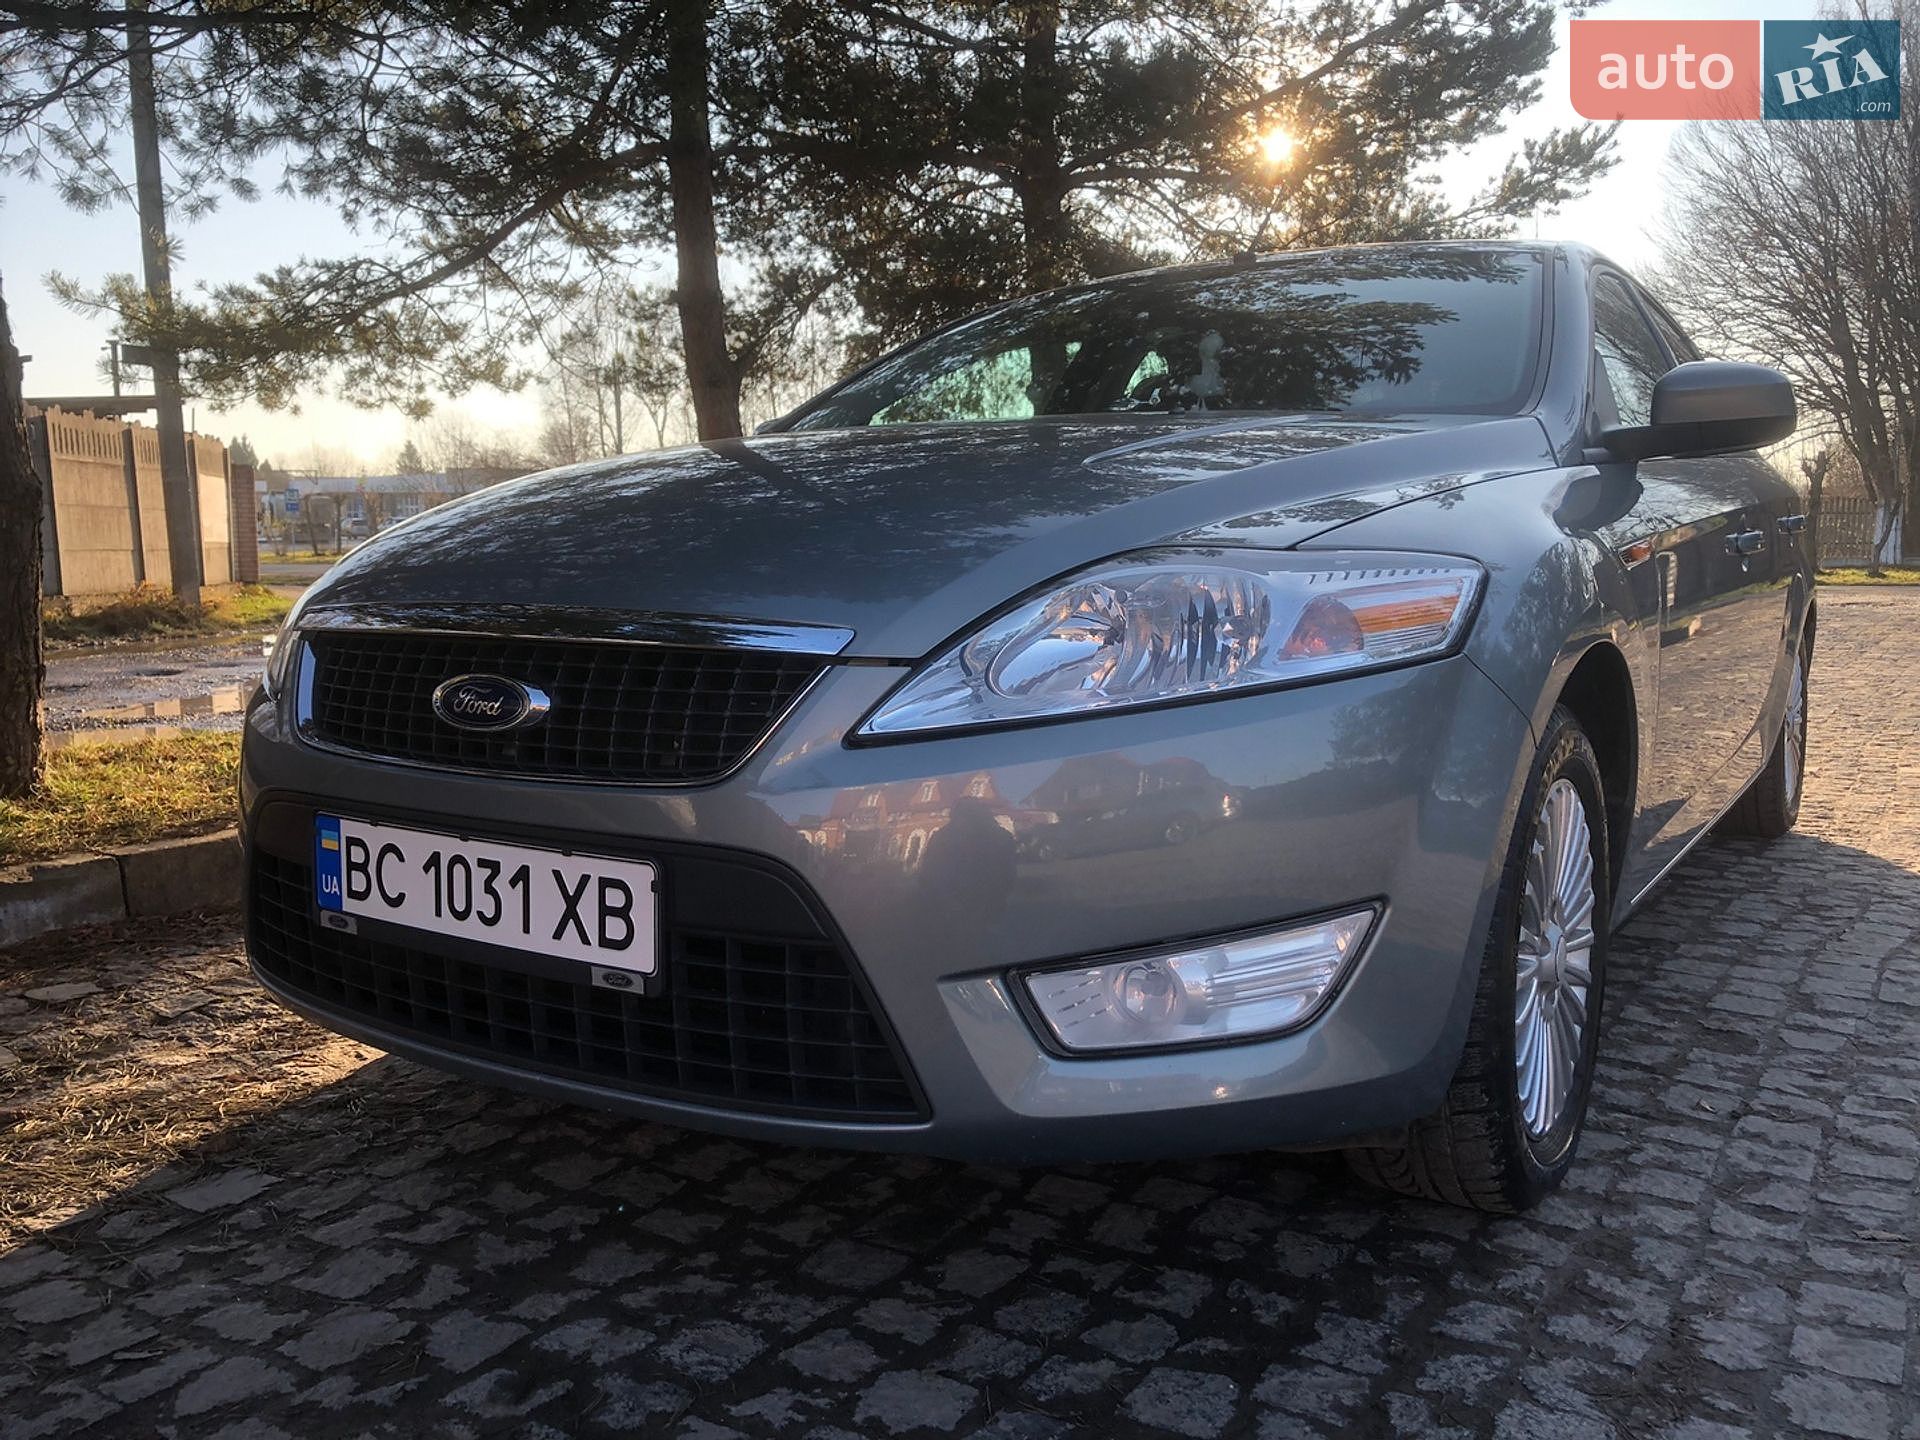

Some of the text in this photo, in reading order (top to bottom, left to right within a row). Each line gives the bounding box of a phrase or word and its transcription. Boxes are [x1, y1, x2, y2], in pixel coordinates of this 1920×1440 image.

[454, 685, 504, 716] Ford
[322, 873, 340, 895] UA
[345, 835, 636, 951] BC 1031 XB
